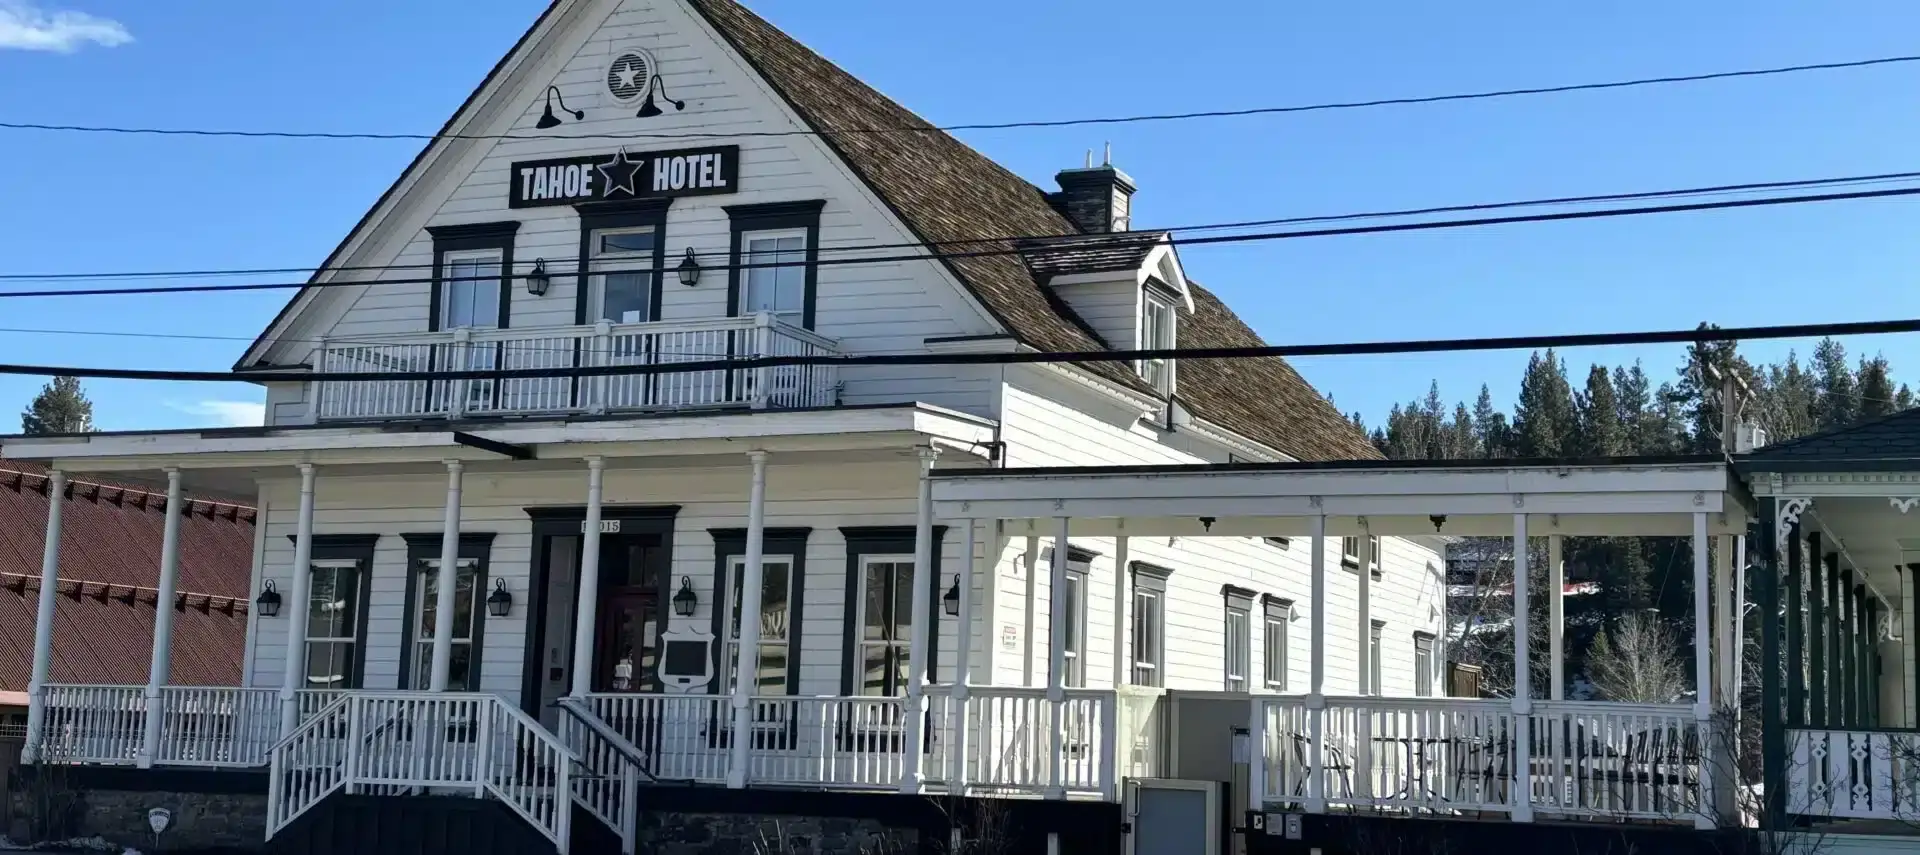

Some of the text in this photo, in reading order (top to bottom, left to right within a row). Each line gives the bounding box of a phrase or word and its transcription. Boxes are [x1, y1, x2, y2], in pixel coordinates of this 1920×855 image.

[520, 153, 727, 201] TAHOE HOTEL
[583, 521, 619, 532] 1015
